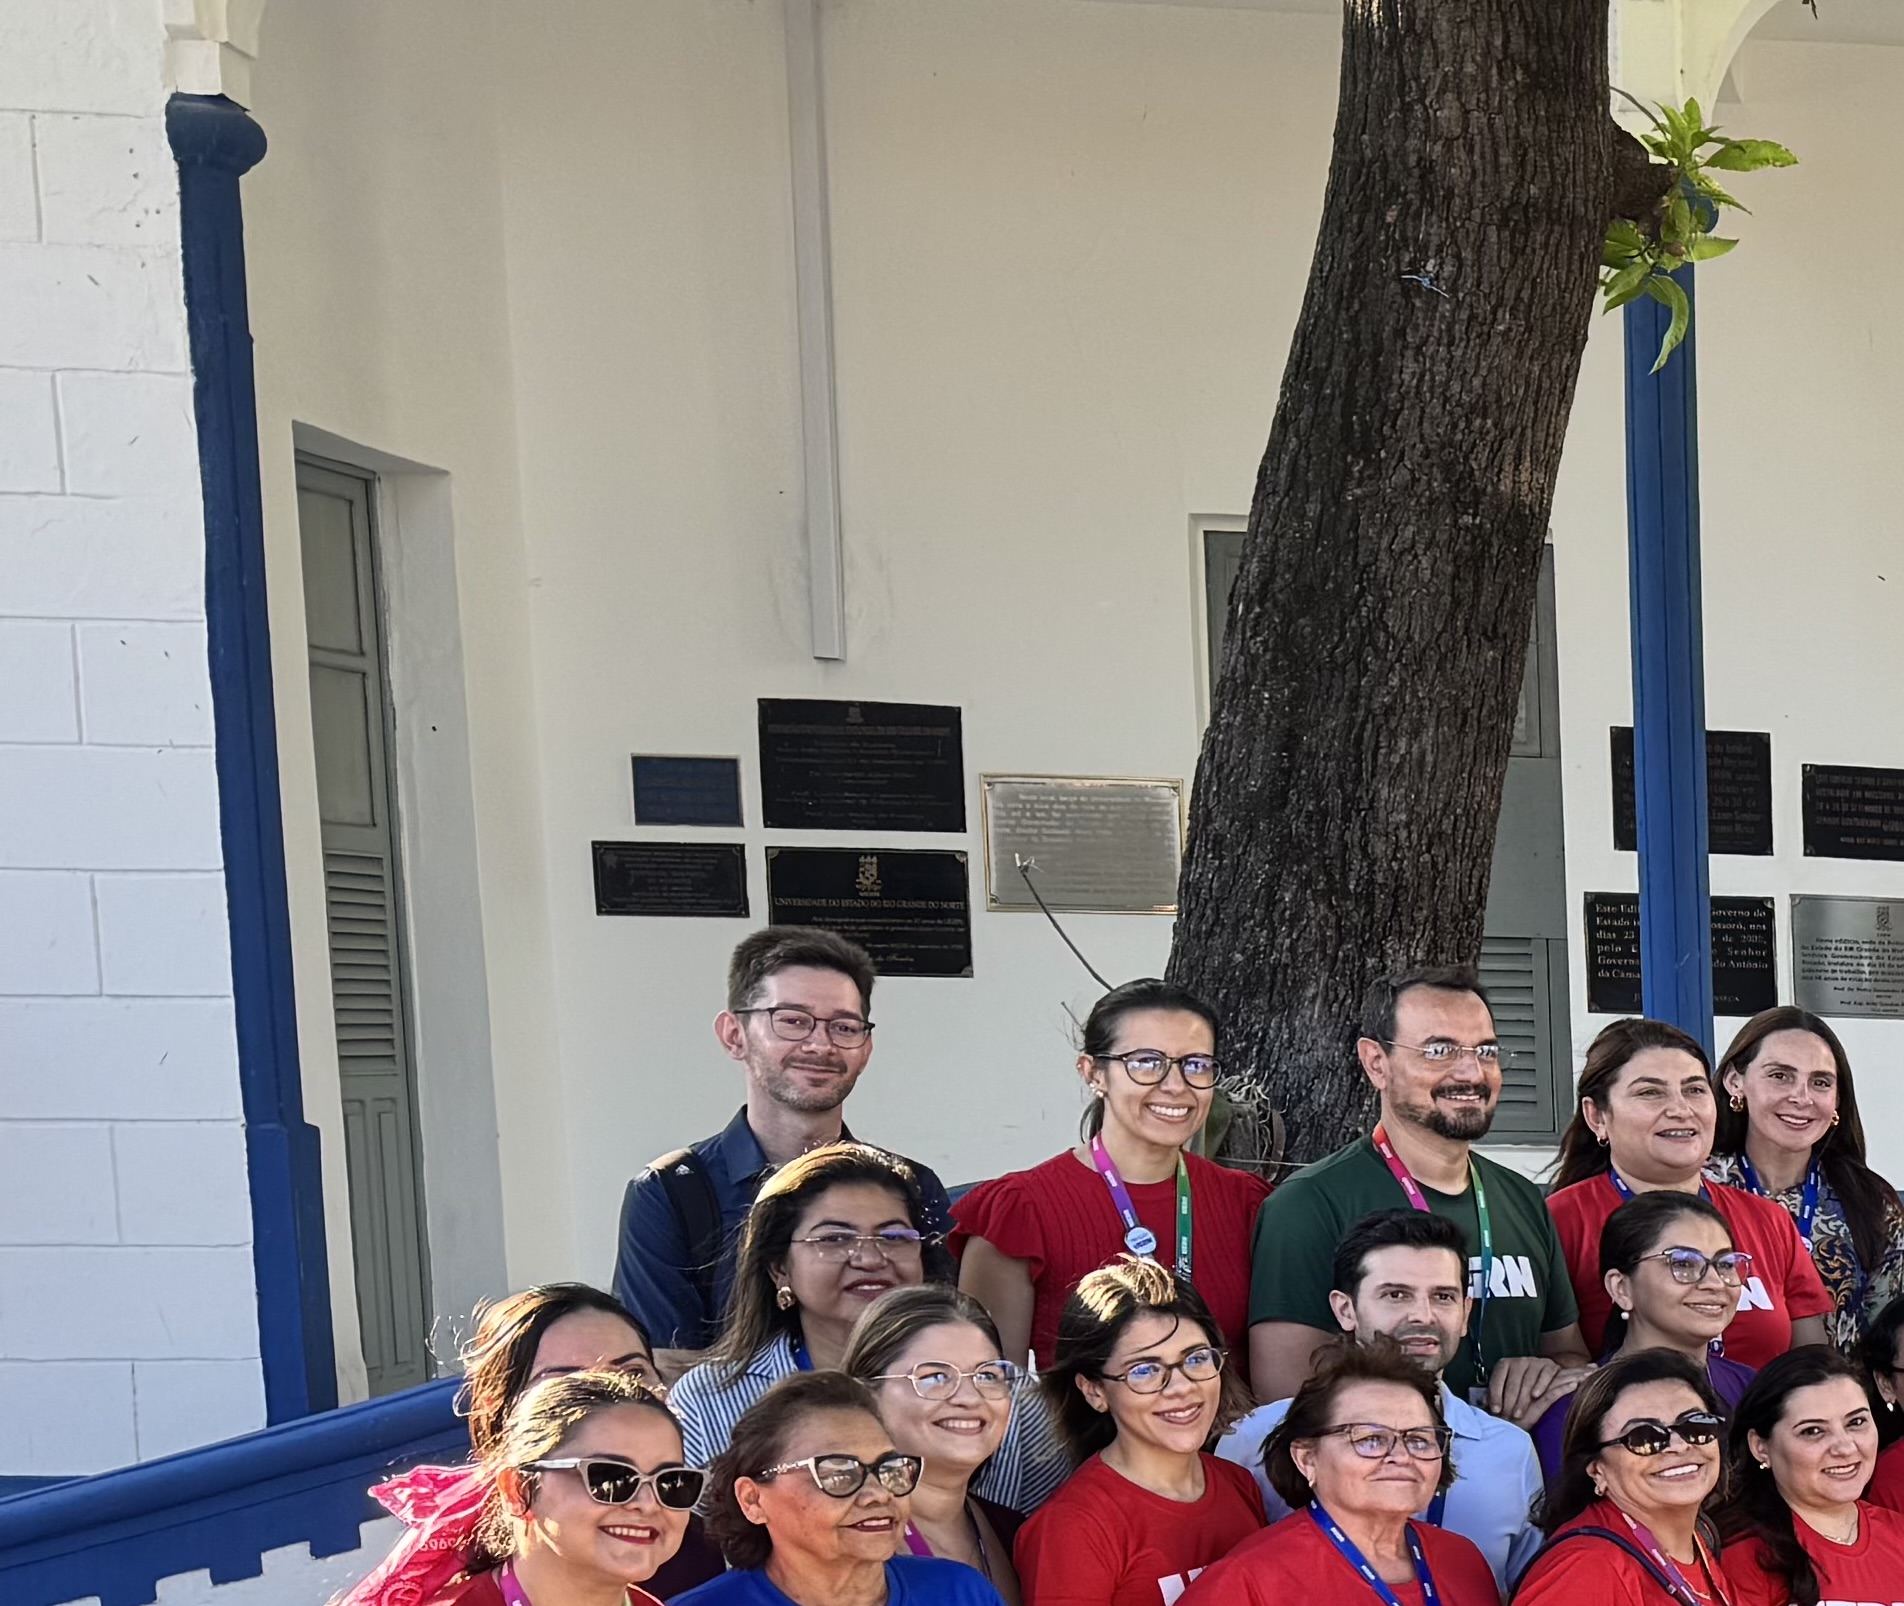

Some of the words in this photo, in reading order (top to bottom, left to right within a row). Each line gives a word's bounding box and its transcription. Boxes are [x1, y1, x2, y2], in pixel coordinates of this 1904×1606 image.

[1712, 908, 1750, 918] overno
[1596, 931, 1616, 939] dias
[1466, 1255, 1538, 1298] ERN
